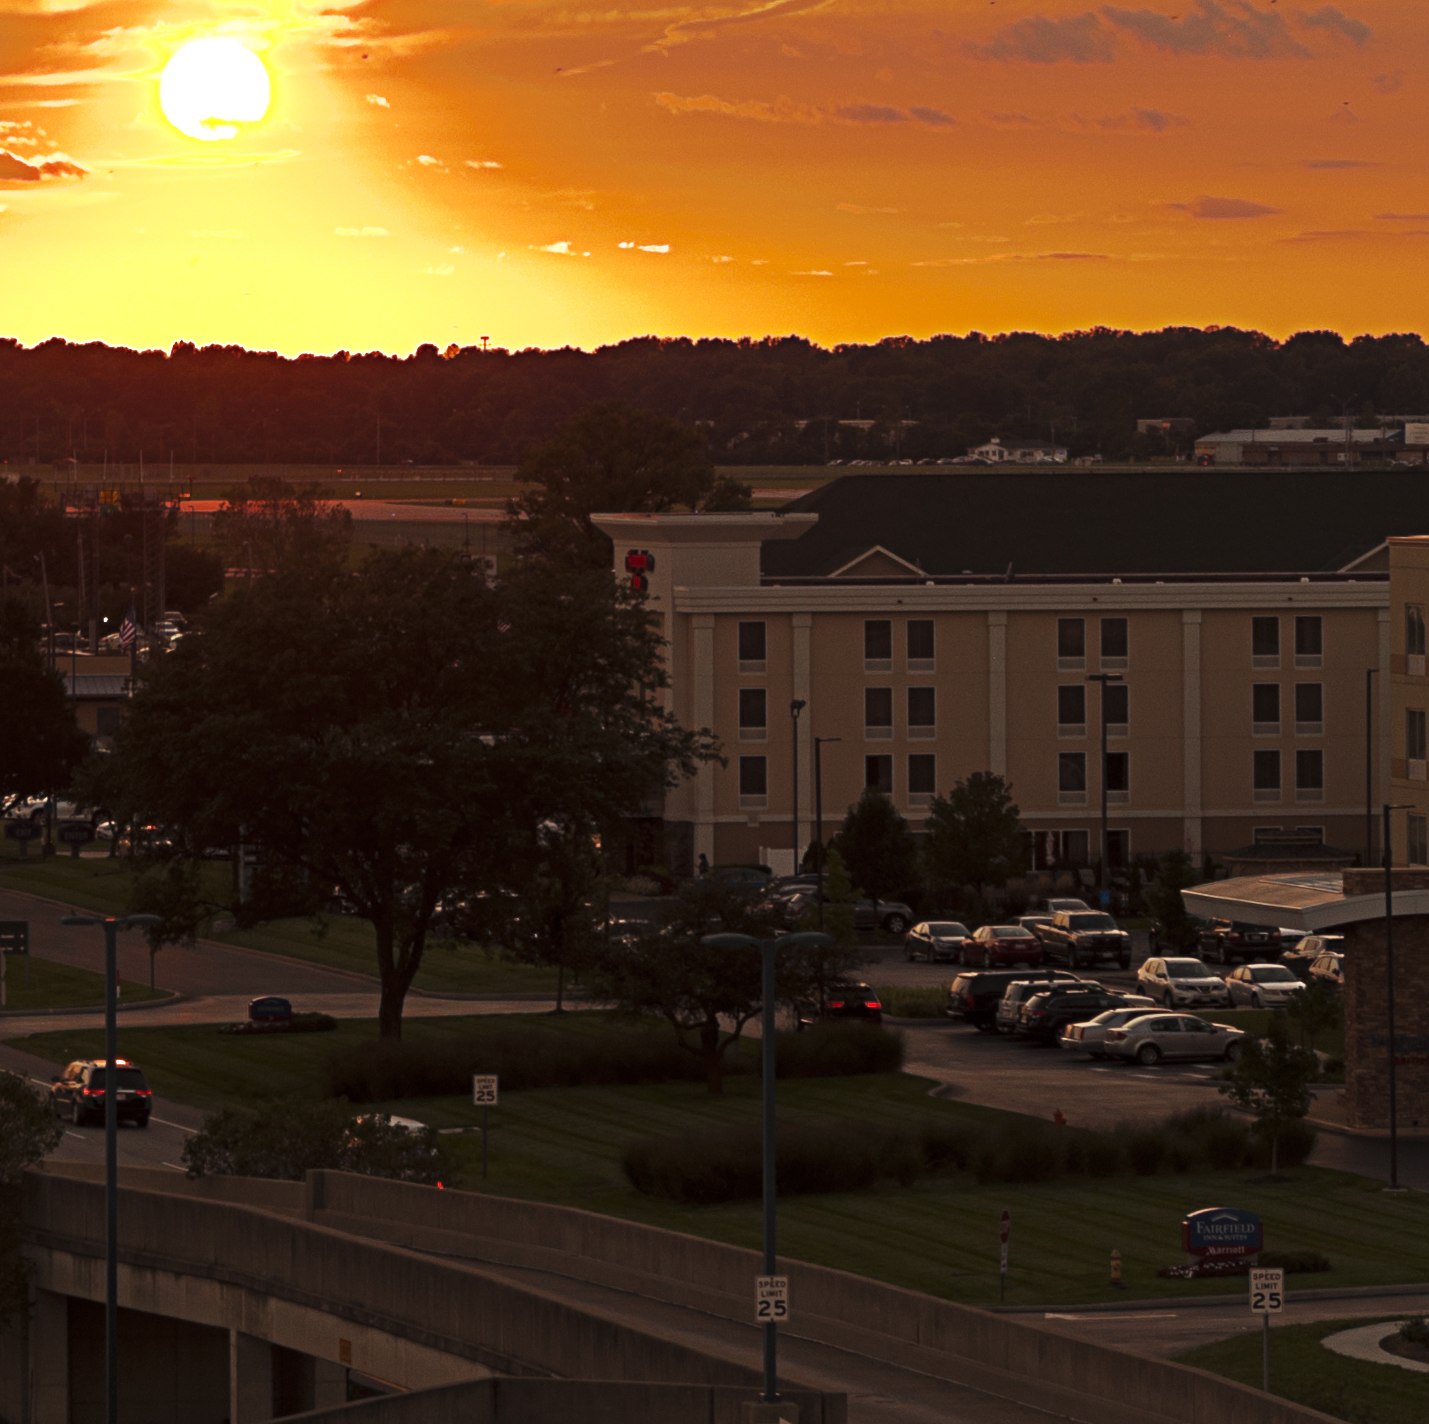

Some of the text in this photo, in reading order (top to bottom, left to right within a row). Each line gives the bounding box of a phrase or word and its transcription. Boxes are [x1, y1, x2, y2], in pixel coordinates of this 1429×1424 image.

[476, 1090, 495, 1102] 25
[1196, 1221, 1255, 1234] FAIRFIELD
[1205, 1245, 1245, 1256] Marriott
[758, 1280, 786, 1288] SPEED
[1253, 1292, 1281, 1309] 25
[758, 1300, 786, 1316] 25
